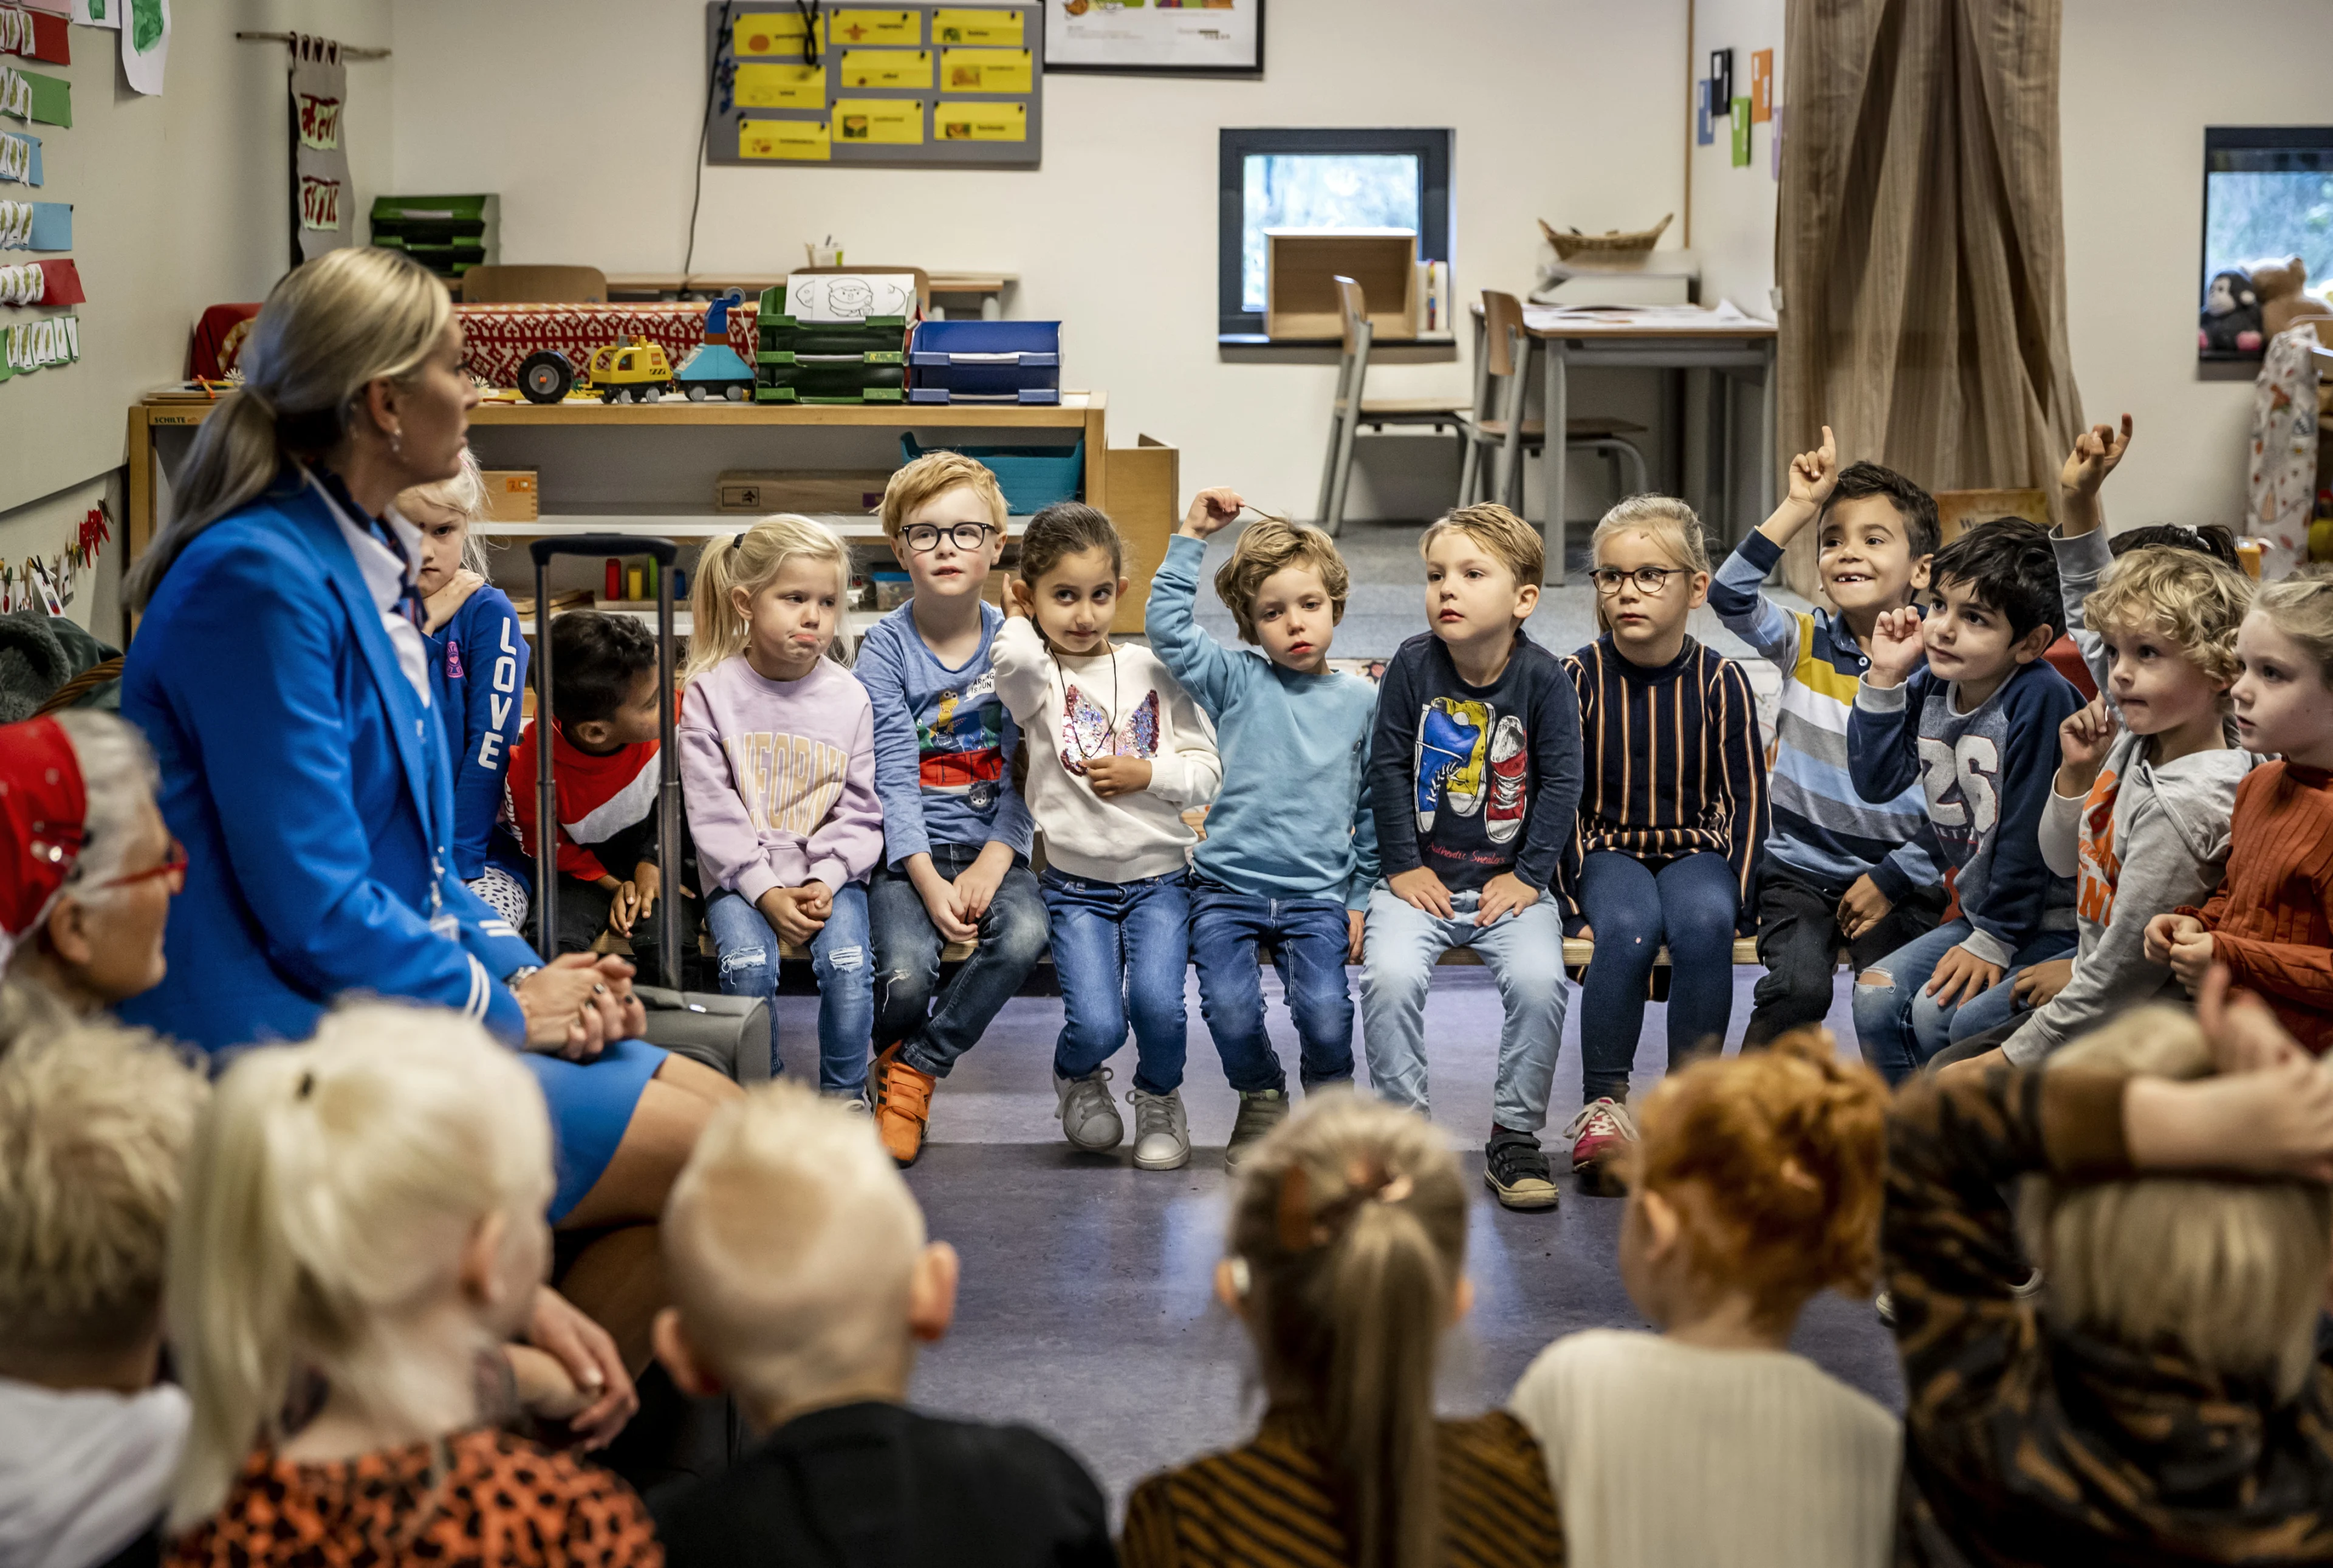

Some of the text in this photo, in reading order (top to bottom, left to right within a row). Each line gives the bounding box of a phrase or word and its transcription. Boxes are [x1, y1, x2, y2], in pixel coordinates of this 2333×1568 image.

[478, 617, 516, 770] LOVE
[979, 681, 992, 691] UN
[1426, 841, 1467, 860] Authentic
